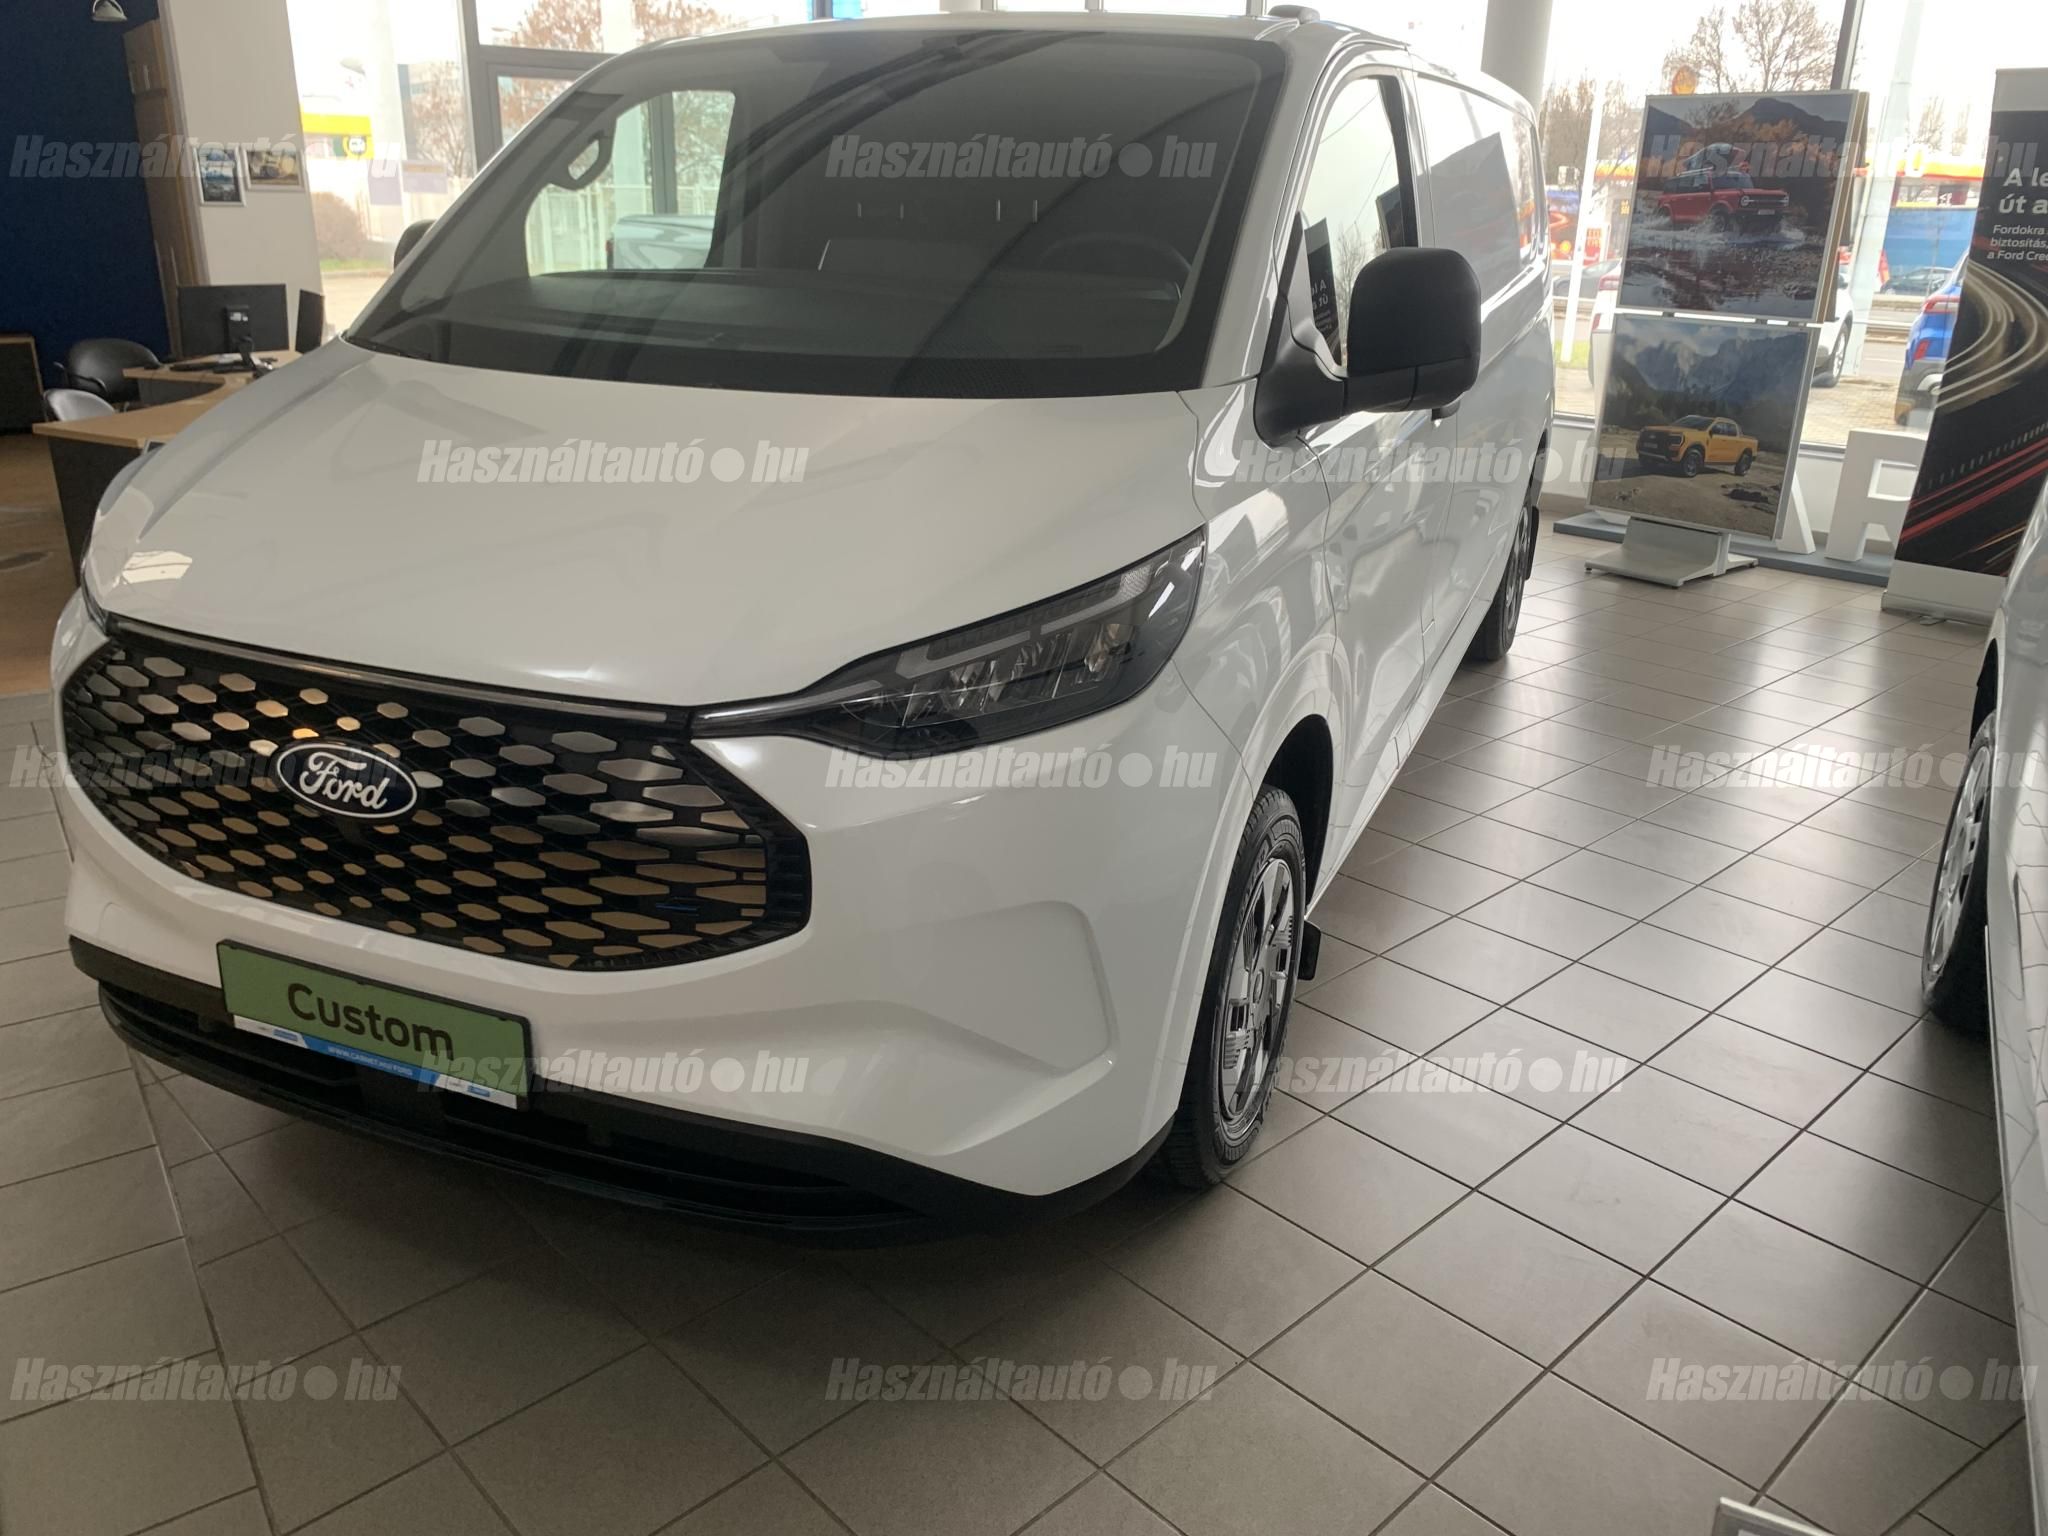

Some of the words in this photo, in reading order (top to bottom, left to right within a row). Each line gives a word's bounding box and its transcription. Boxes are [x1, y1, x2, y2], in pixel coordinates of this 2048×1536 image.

[2003, 167, 2022, 187] A
[1999, 193, 2027, 214] út
[1993, 224, 2045, 235] Fordokra
[1987, 251, 1995, 259] a
[1998, 250, 2025, 260] Ford
[2026, 250, 2048, 261] Cre
[299, 751, 390, 810] Ford
[287, 982, 455, 1061] Custom
